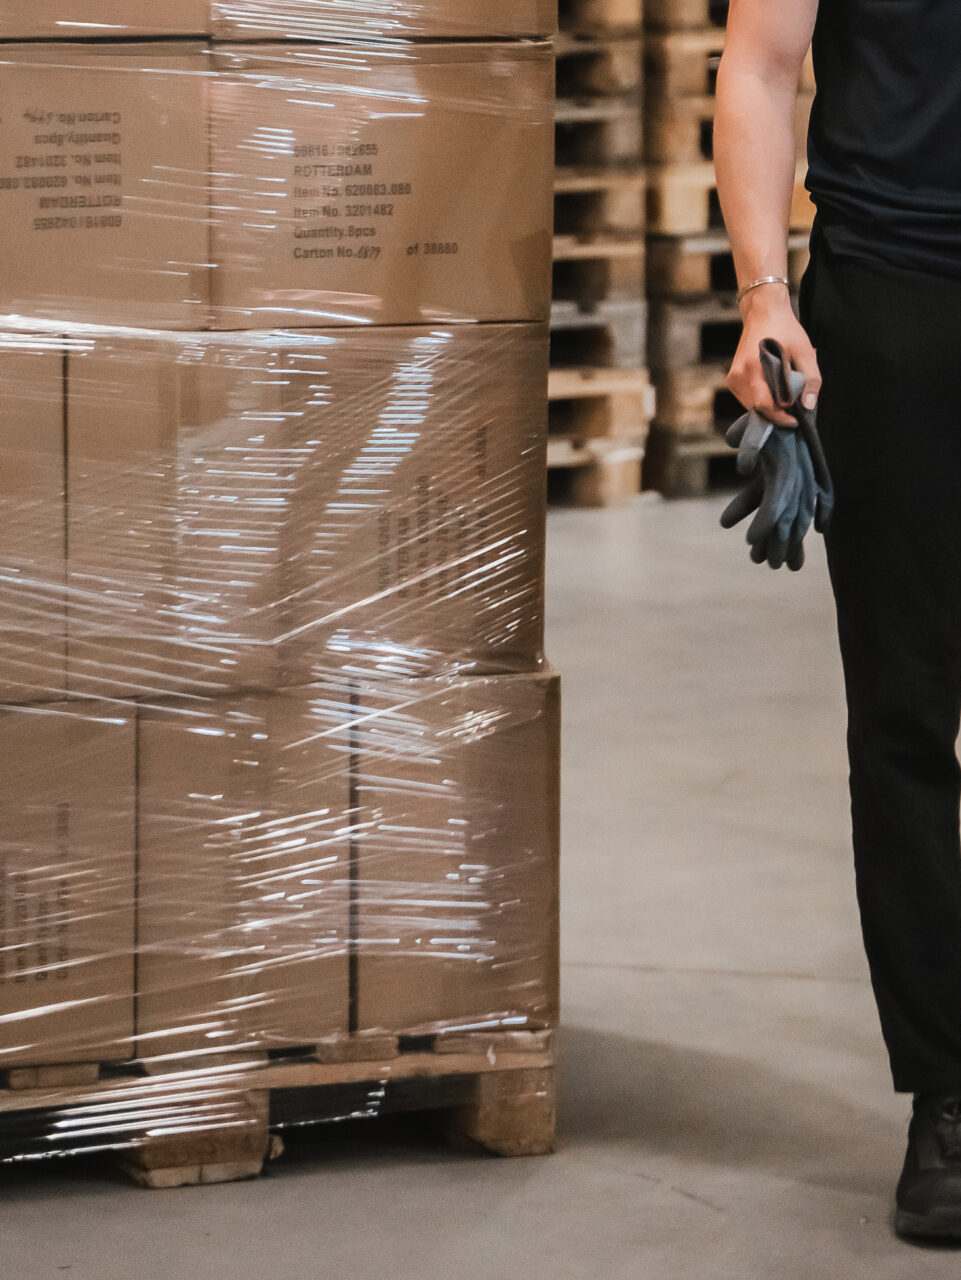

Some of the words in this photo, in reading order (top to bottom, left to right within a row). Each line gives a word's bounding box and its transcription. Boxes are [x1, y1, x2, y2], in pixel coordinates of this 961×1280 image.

[294, 164, 373, 177] ROTTERDAM
[294, 186, 320, 198] Item
[345, 183, 412, 196] 620083.080
[40, 194, 121, 209] ROTTERDAM
[294, 206, 320, 219] Item
[322, 205, 340, 218] No.
[345, 204, 394, 217] 3201482
[293, 246, 335, 260] Carton
[406, 243, 420, 256] of
